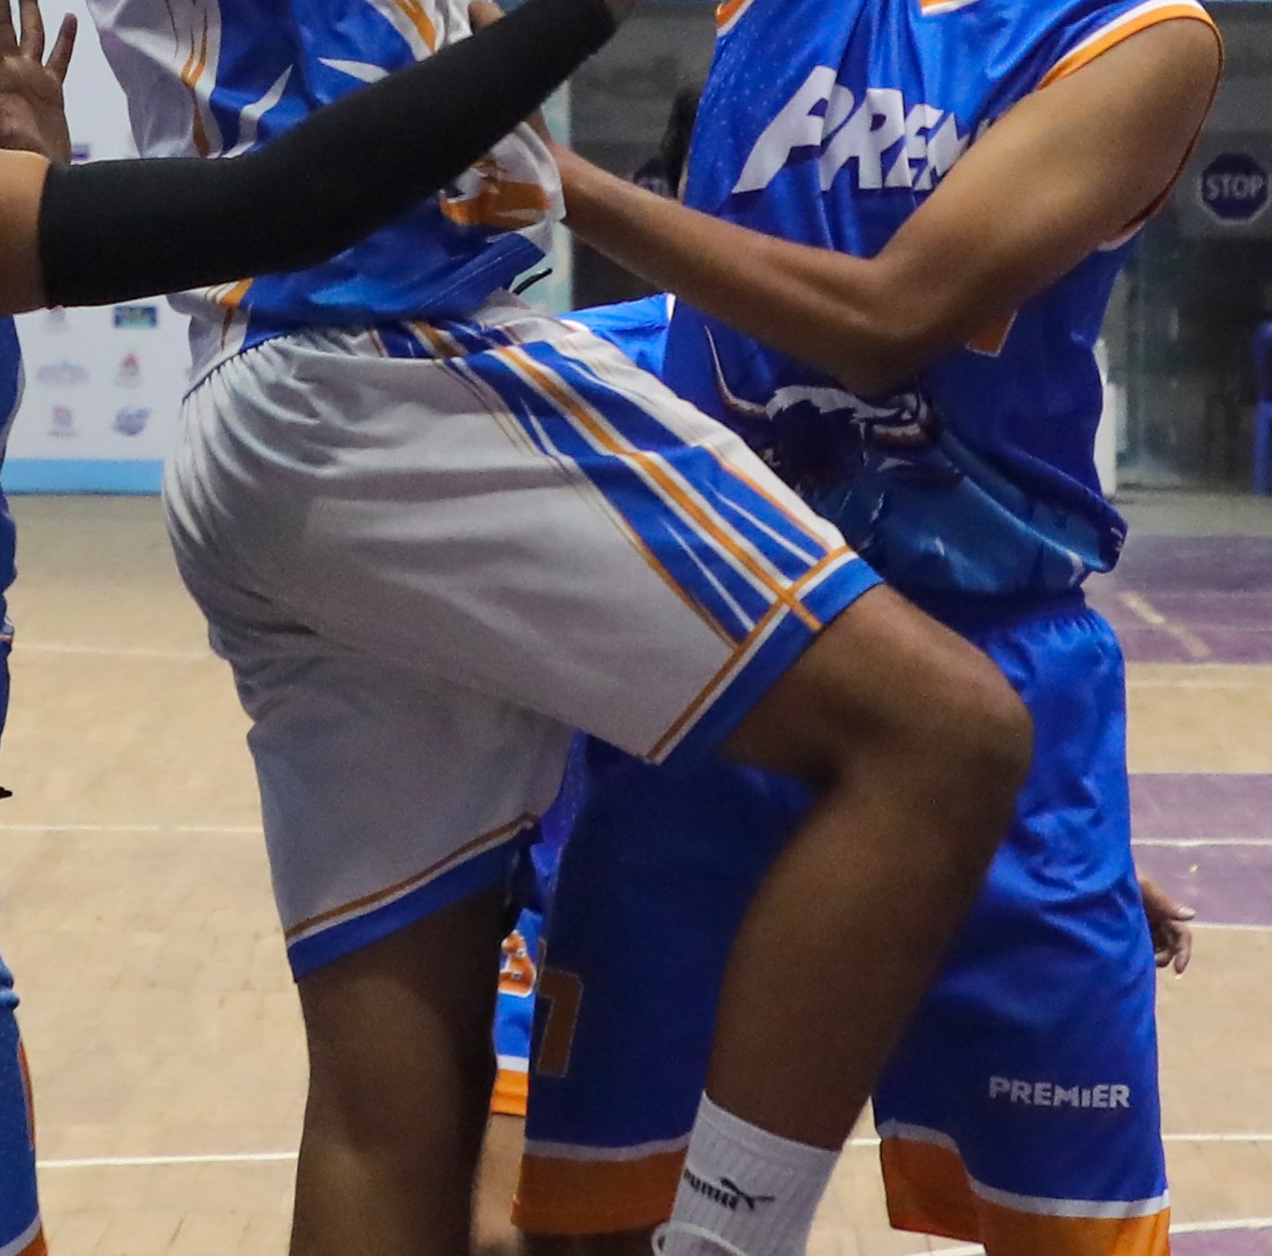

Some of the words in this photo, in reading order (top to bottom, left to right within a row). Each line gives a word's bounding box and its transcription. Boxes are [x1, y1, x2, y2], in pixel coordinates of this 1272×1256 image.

[730, 63, 991, 194] PREM
[1205, 173, 1265, 201] STOP
[989, 1075, 1131, 1109] PREMIER
